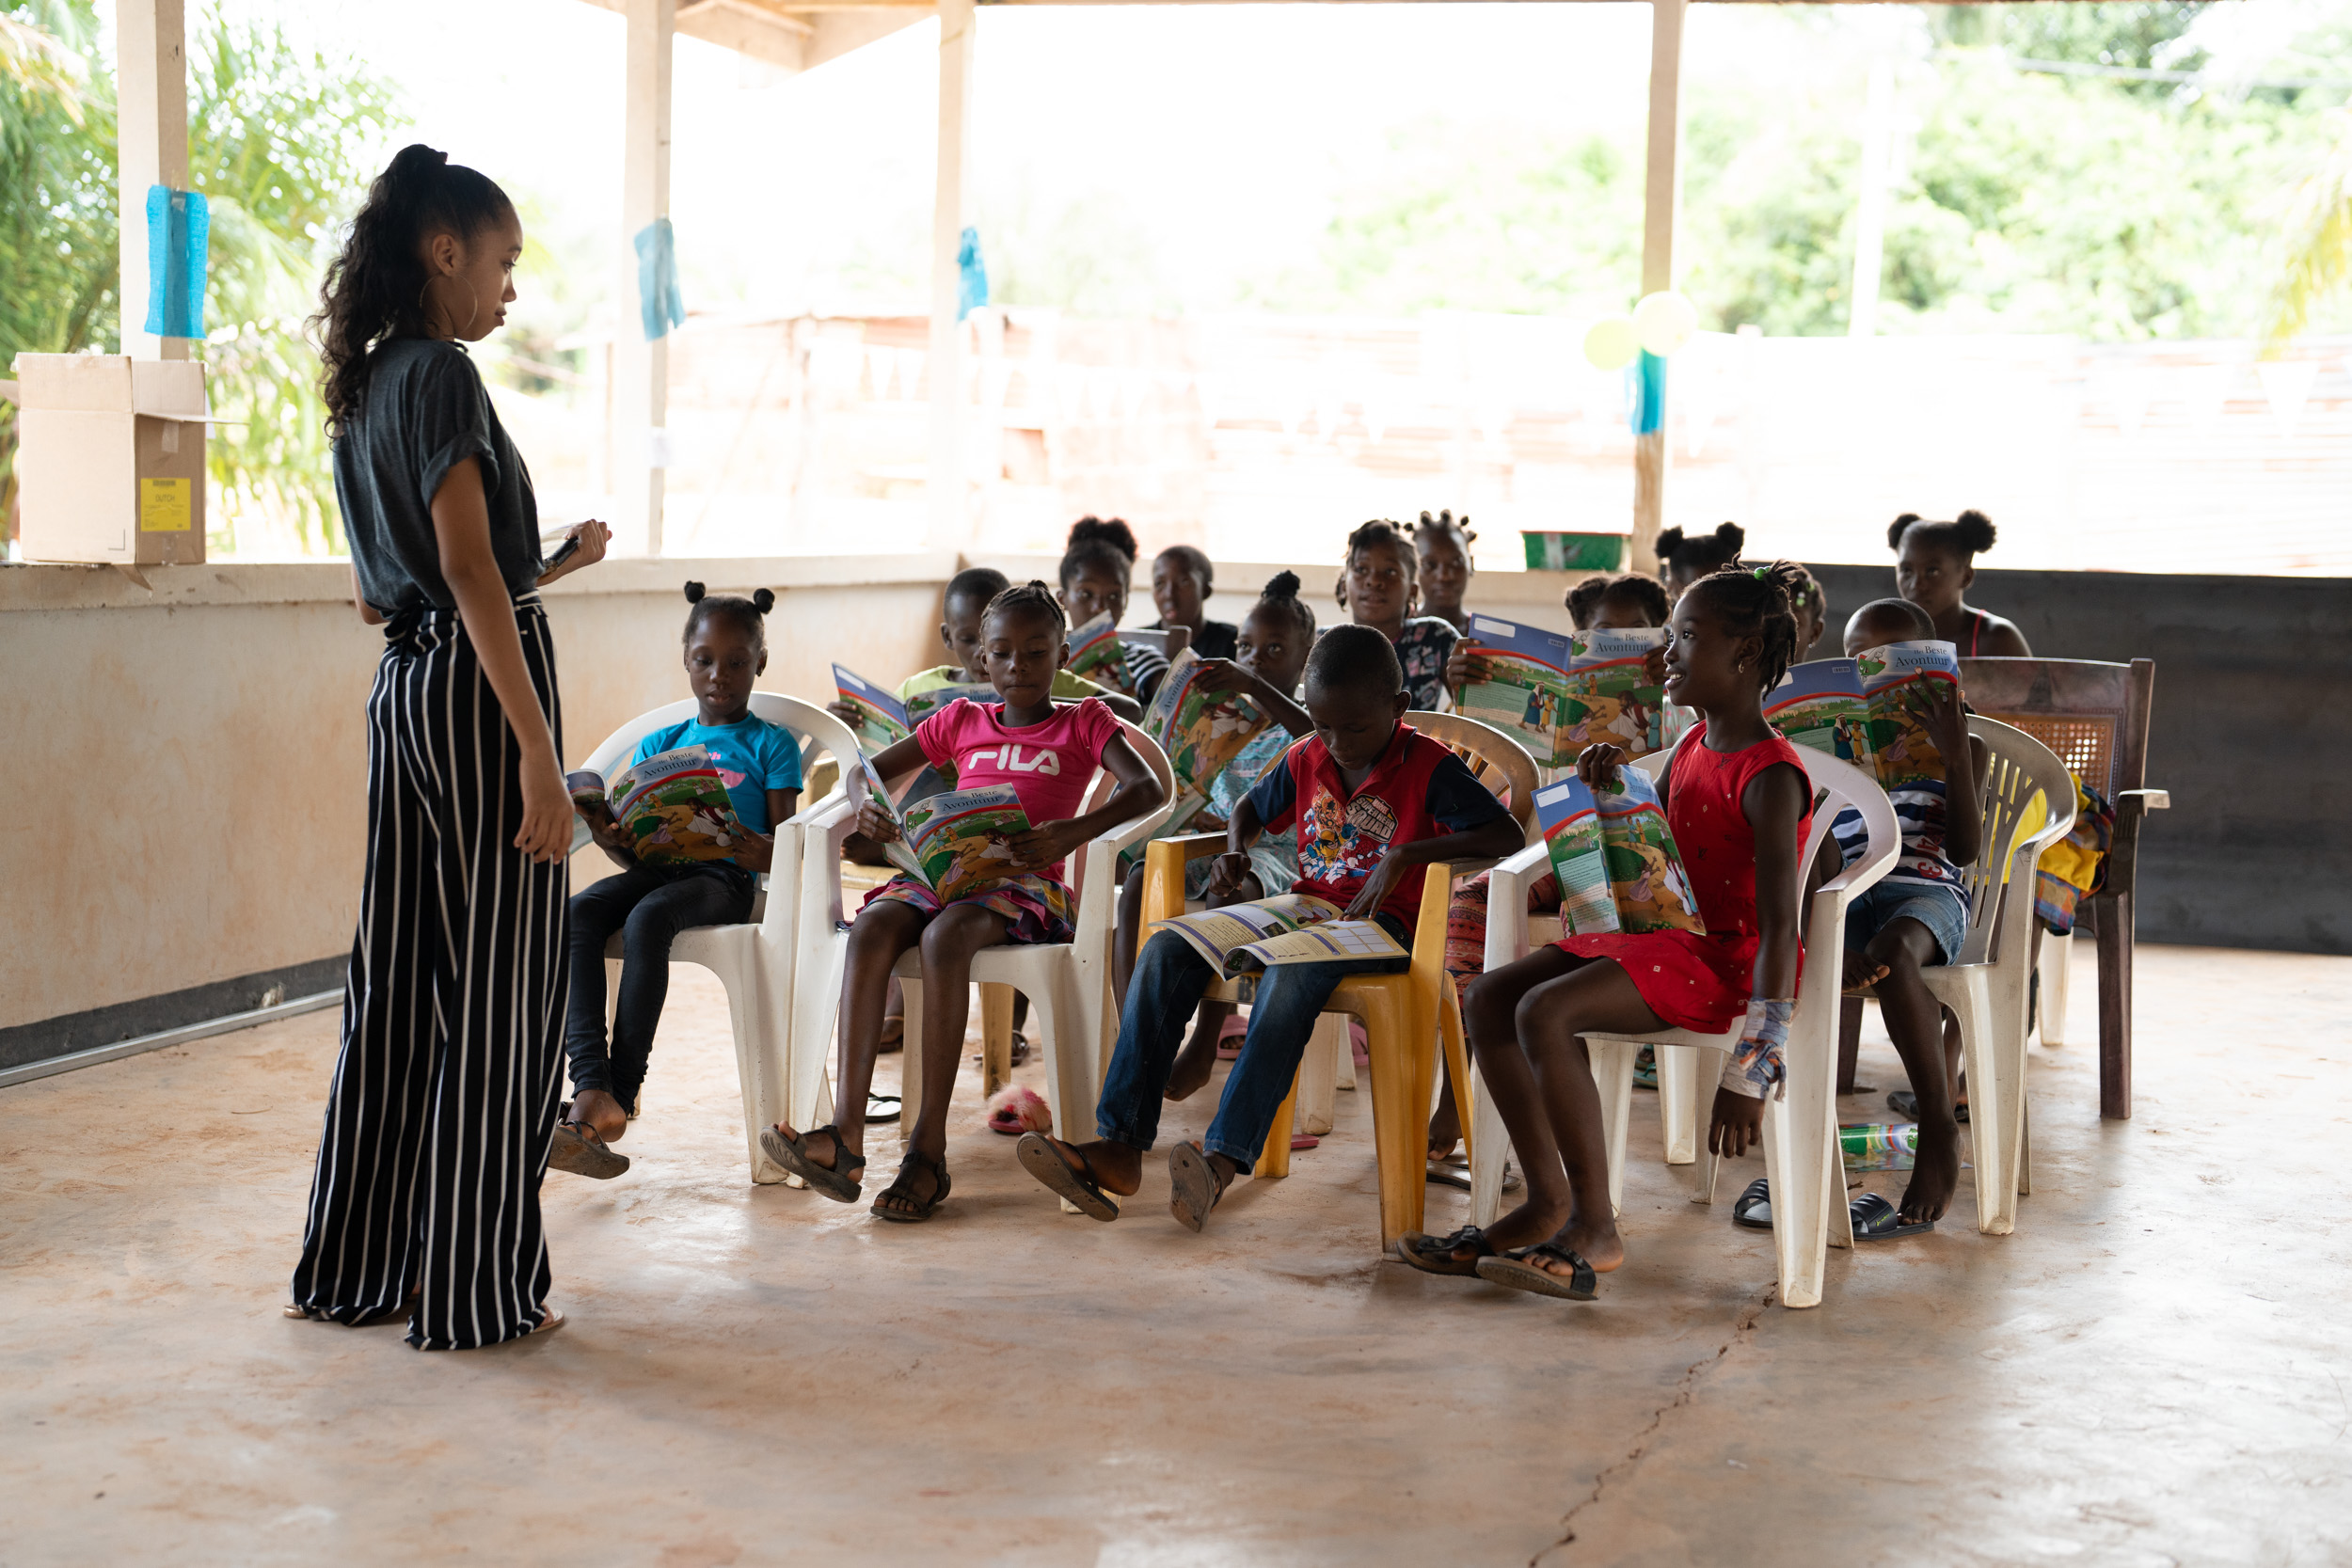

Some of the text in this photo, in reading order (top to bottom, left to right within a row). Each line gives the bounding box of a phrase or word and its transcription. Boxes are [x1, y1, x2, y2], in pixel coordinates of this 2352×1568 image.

[1625, 633, 1649, 641] Beste
[1925, 645, 1947, 655] Beste
[1895, 656, 1948, 668] Avontuur
[668, 752, 693, 761] Beste
[968, 743, 1060, 776] FILA
[644, 758, 697, 779] Avontuur
[971, 790, 997, 799] Beste
[943, 796, 1001, 812] Avontuur
[1345, 801, 1392, 840] SQUAD
[1356, 797, 1395, 831] SUPER HERO
